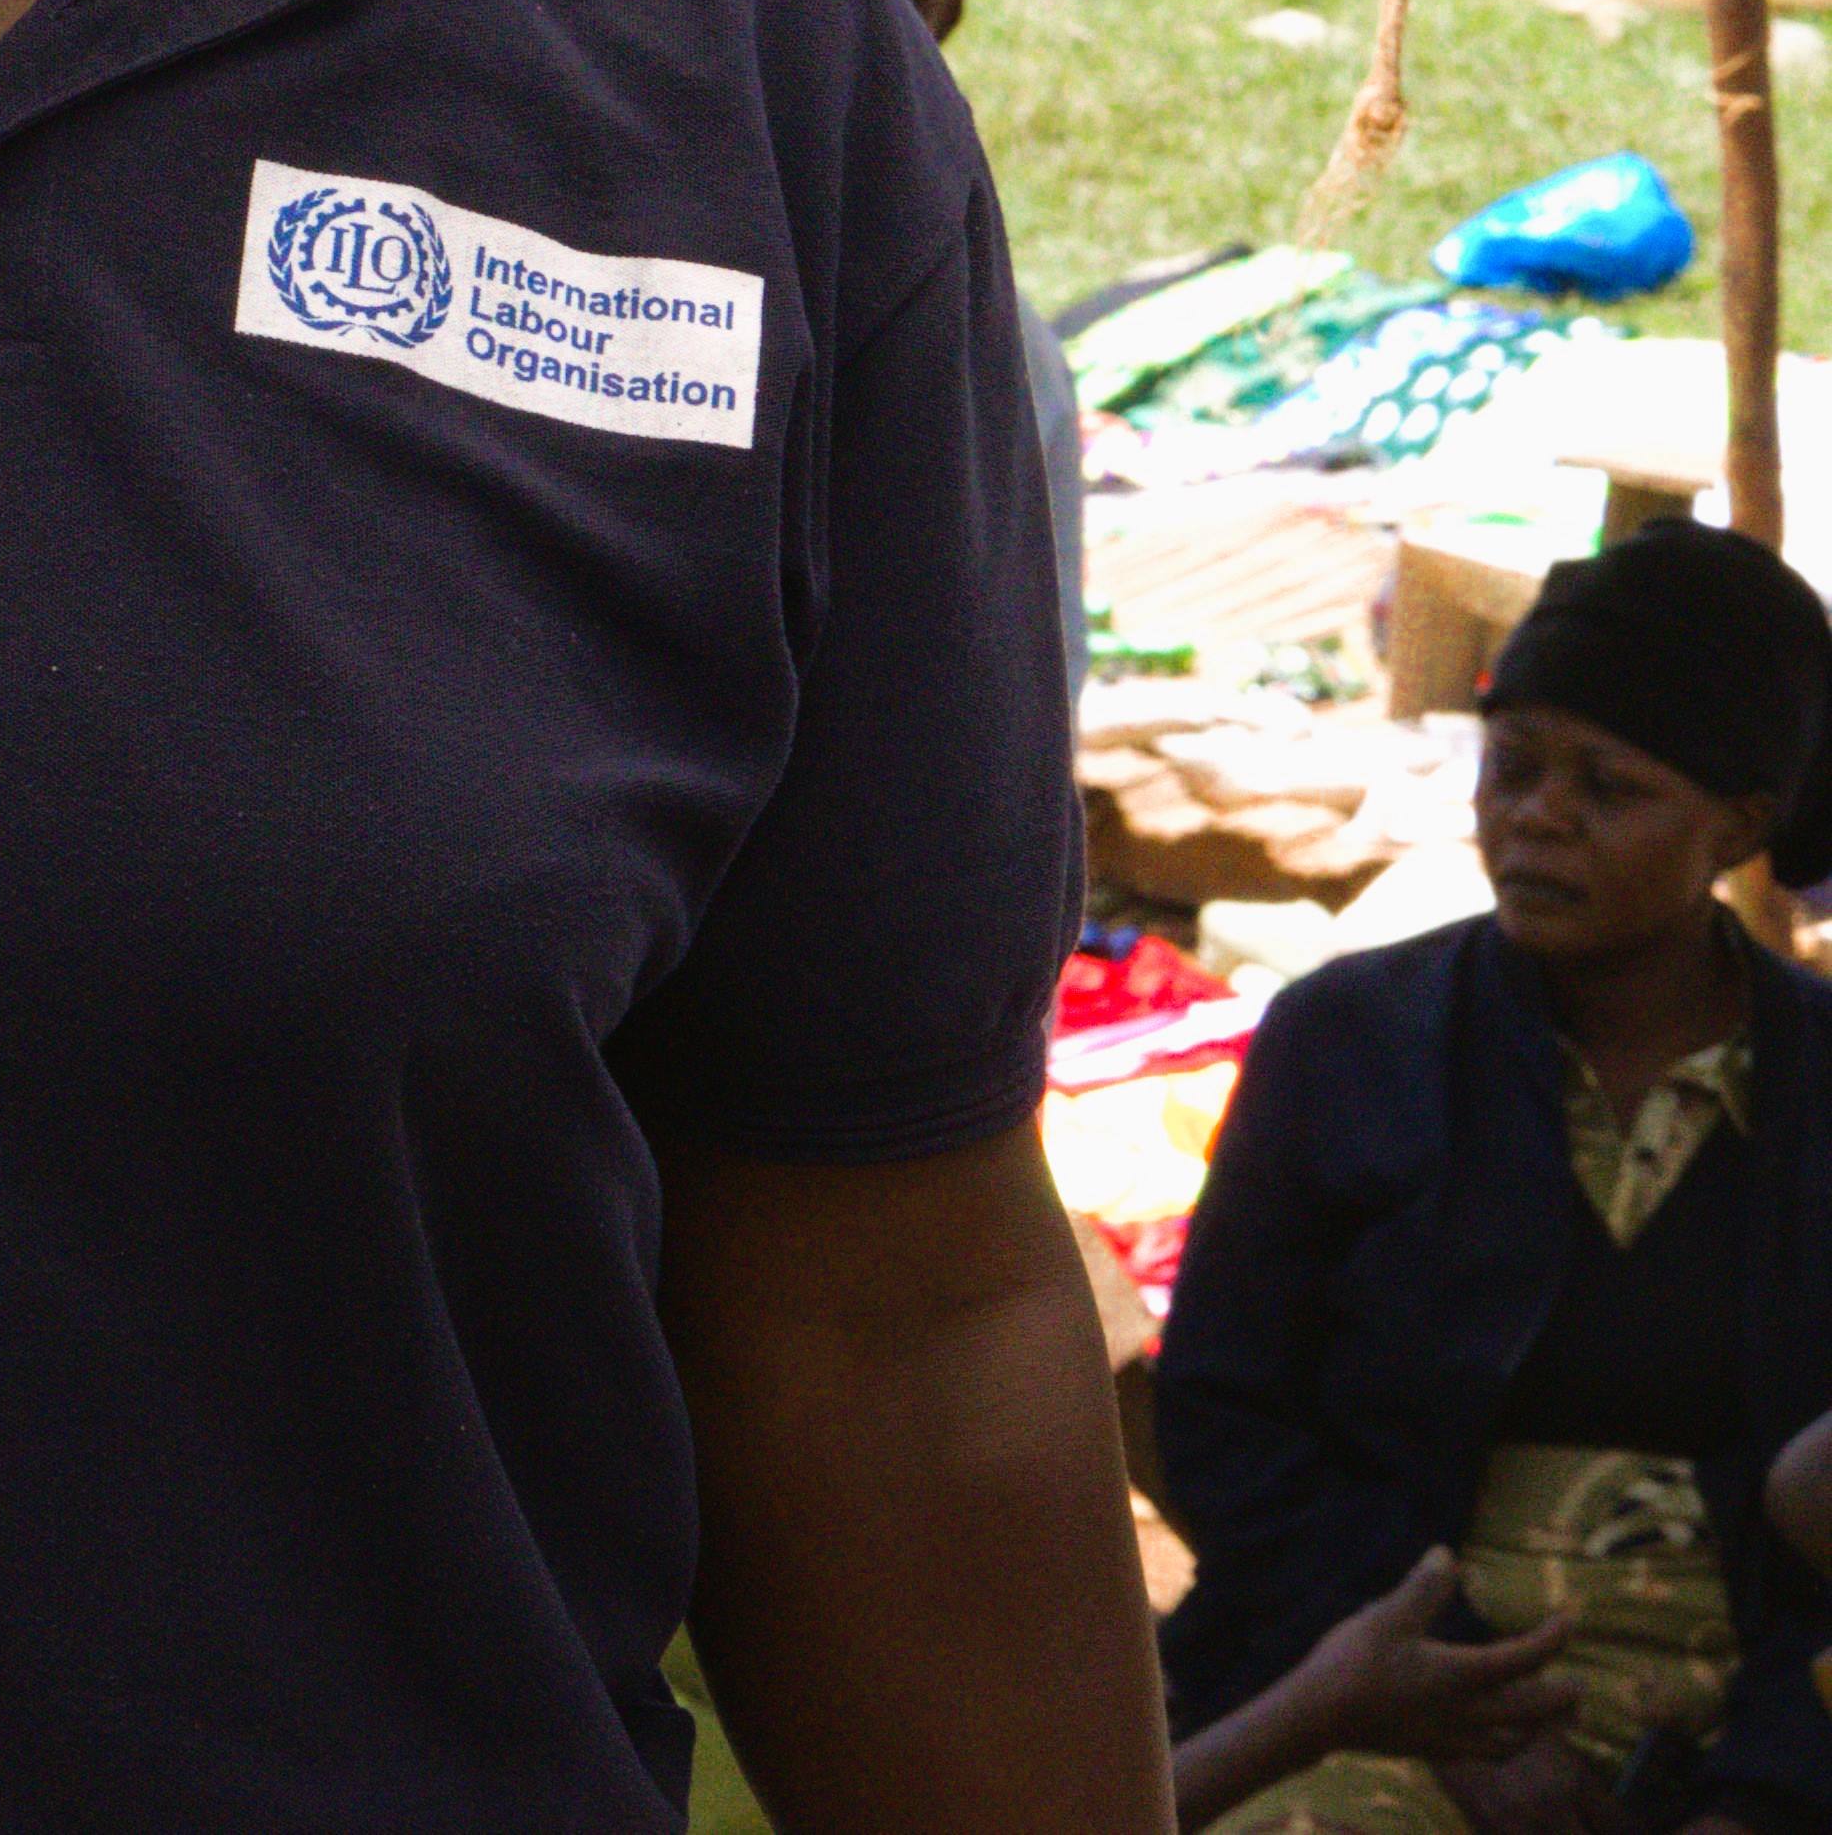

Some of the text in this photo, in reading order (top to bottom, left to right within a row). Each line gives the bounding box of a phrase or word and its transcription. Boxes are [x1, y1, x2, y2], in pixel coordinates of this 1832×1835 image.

[324, 221, 415, 295] ILO
[473, 245, 735, 331] International
[468, 290, 614, 356] Labour
[465, 326, 738, 411] Organisation
